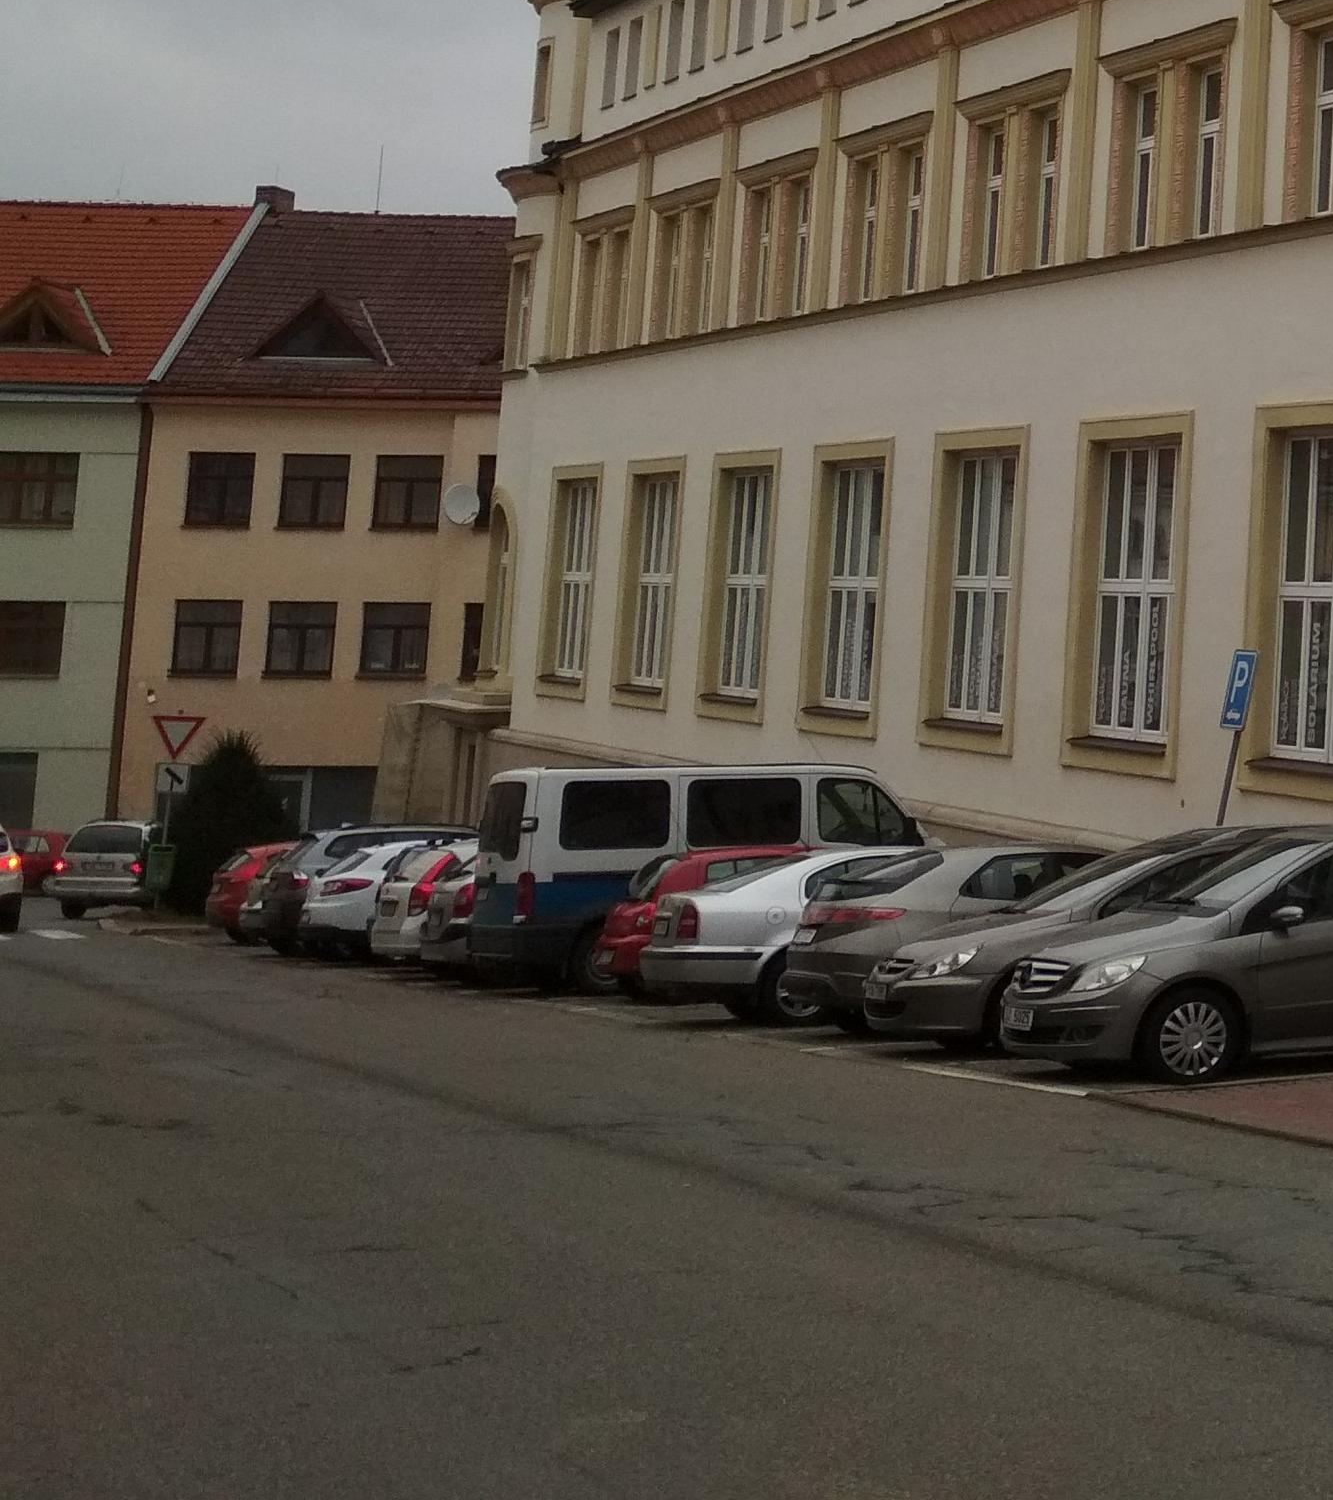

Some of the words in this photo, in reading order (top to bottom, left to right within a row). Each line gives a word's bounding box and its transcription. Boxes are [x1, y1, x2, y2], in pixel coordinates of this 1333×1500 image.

[1120, 649, 1131, 723] SAUNA
[1146, 601, 1160, 725] WHIRLPOOL
[1230, 660, 1250, 704] P
[1307, 622, 1321, 743] SOLARIUM
